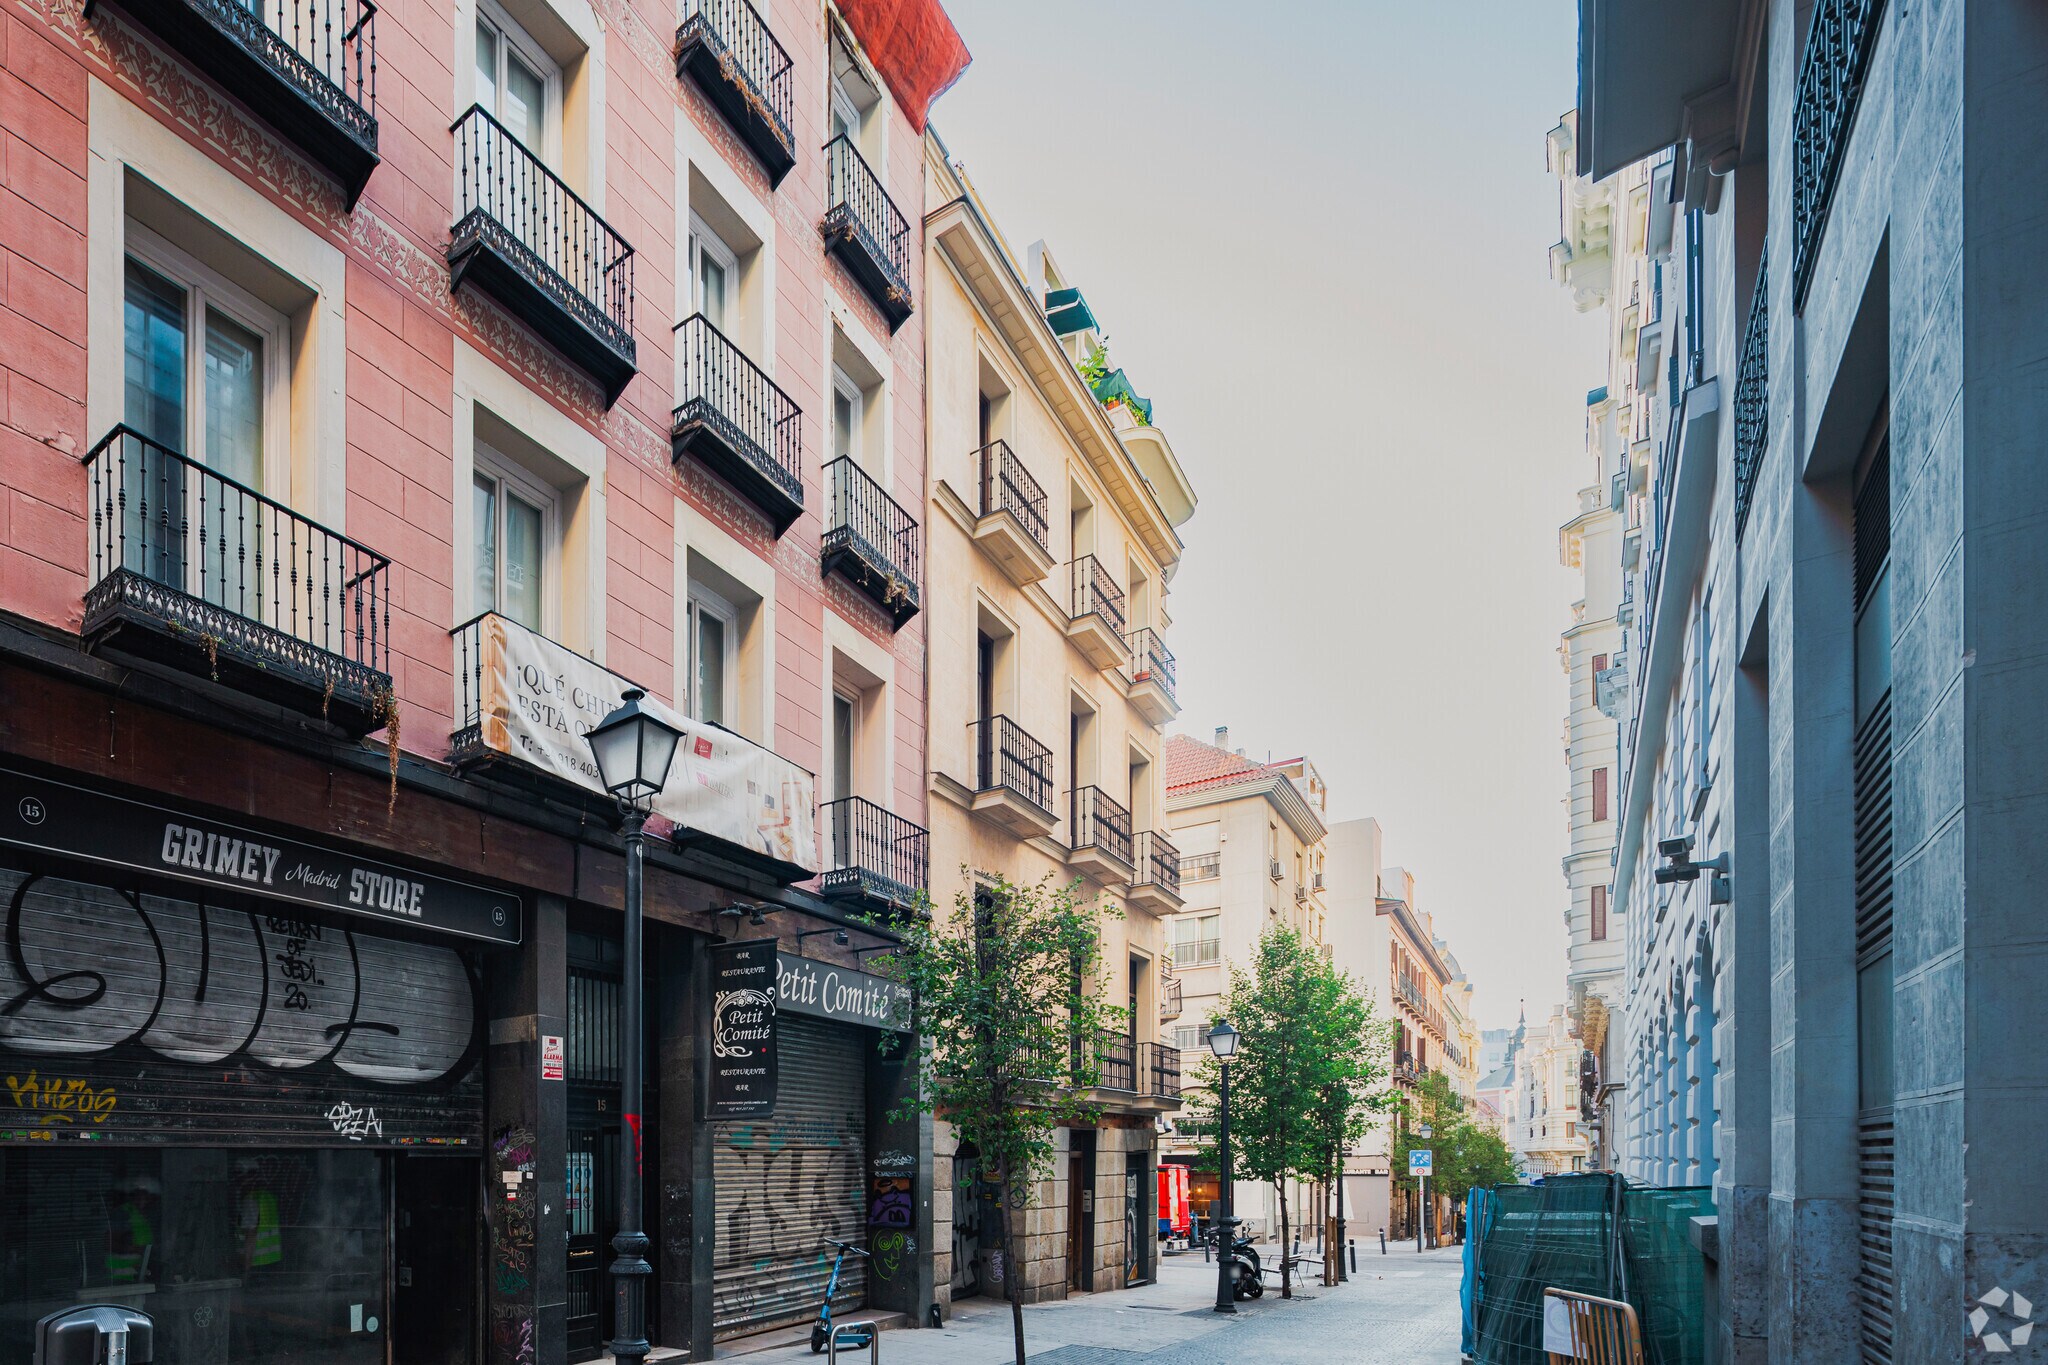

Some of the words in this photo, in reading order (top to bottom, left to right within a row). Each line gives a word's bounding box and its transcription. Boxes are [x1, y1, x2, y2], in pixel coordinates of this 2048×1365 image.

[517, 664, 565, 702] ¡QUÉ
[572, 687, 620, 718] CHU
[517, 693, 570, 734] ESTÁ
[25, 803, 40, 818] 15
[161, 823, 282, 886] GRIMEY
[285, 862, 341, 890] Madrid
[348, 868, 425, 918] STORE
[494, 910, 504, 922] 15
[736, 952, 750, 960] BAR
[721, 966, 766, 977] RESTAURANTE
[823, 972, 889, 1019] Comité
[729, 1008, 763, 1025] Petit
[723, 1024, 770, 1043] Comité
[720, 1068, 766, 1076] RESTAURANTE
[735, 1084, 750, 1092] BAR
